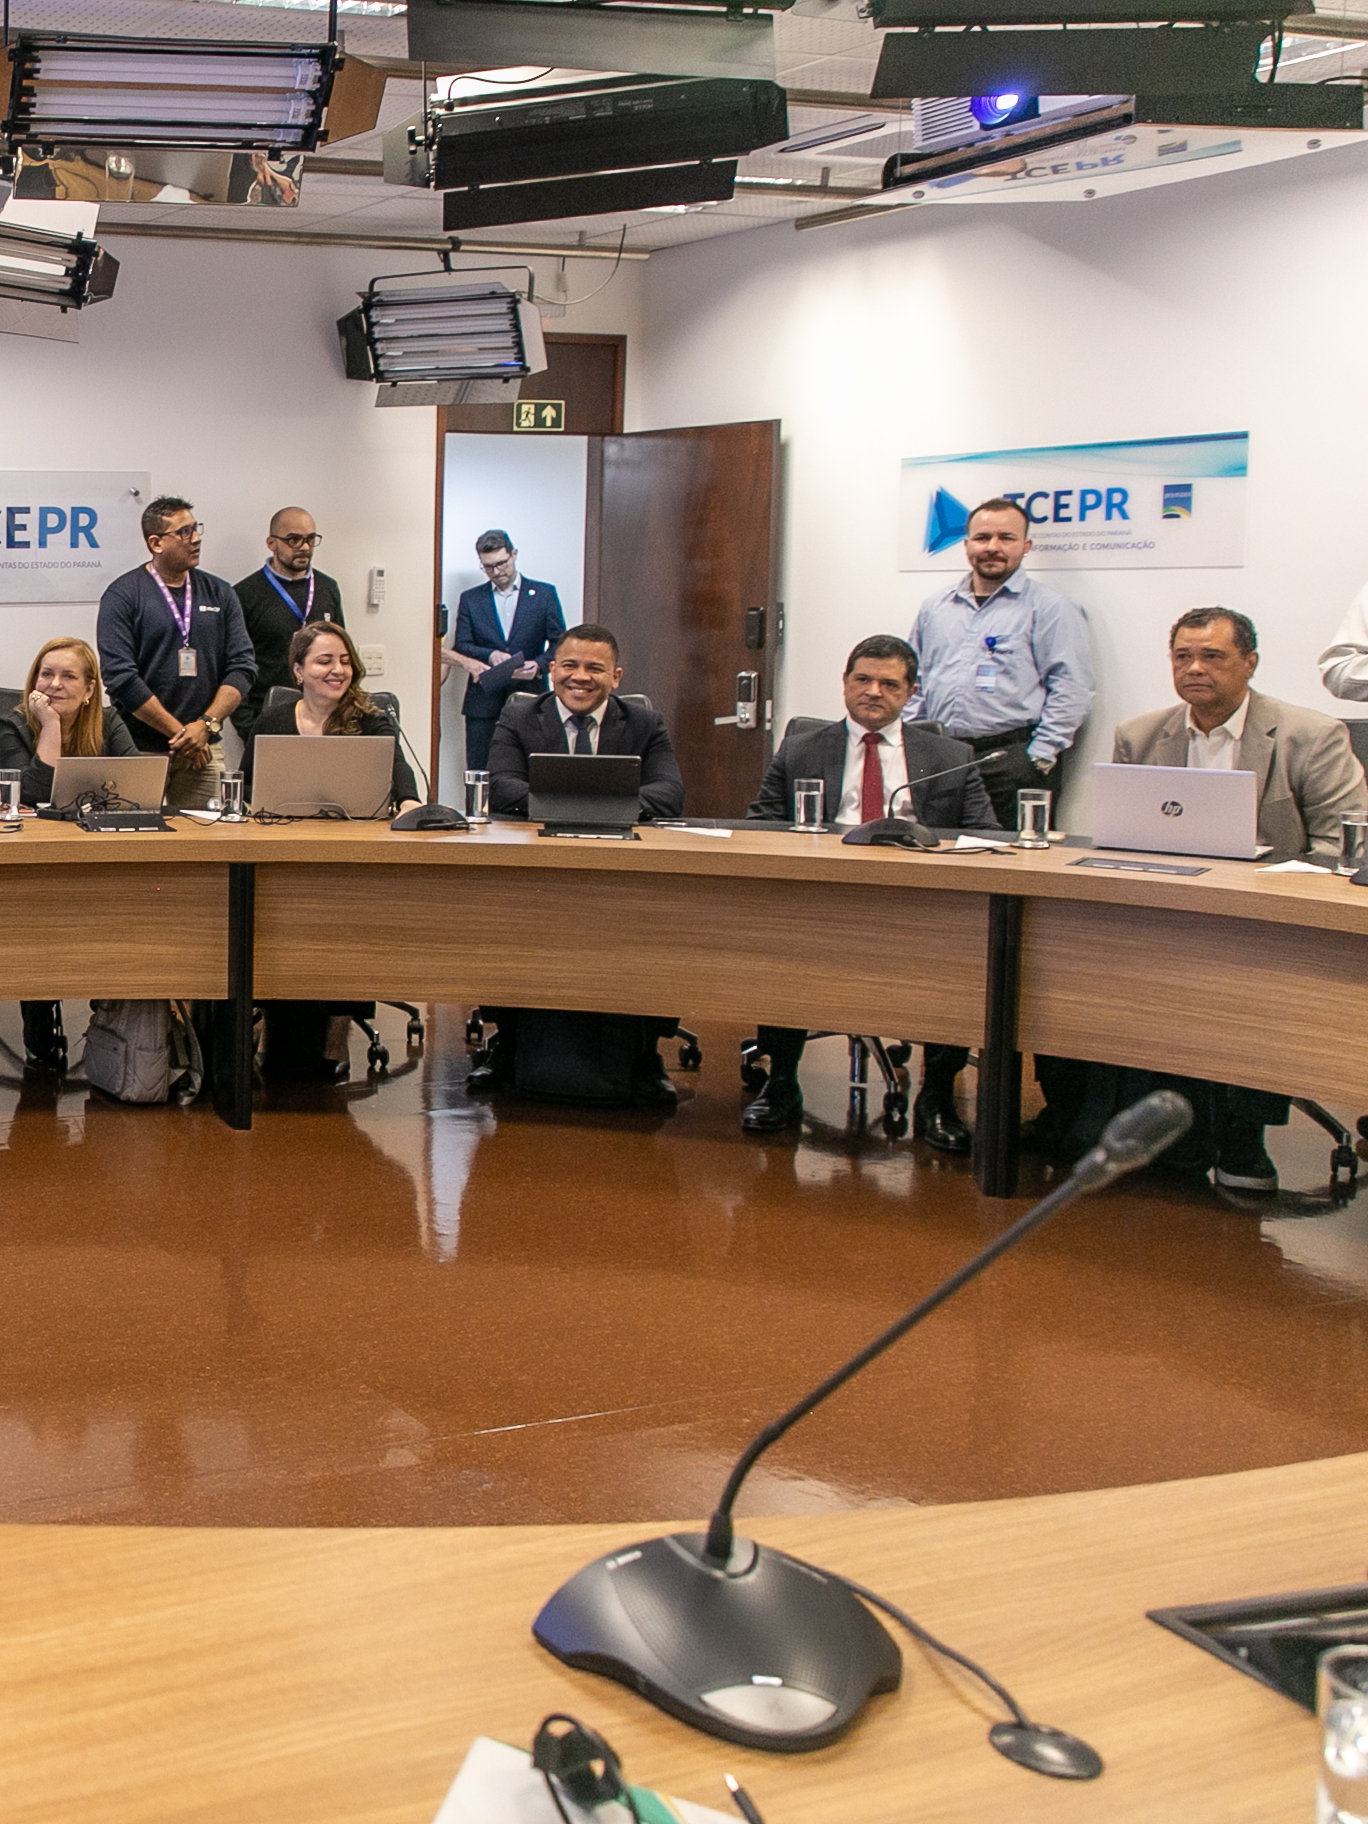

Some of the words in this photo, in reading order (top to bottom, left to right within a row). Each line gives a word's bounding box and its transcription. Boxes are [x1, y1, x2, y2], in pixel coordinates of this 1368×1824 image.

[1031, 542, 1080, 552] FORMAÇÃO
[1089, 540, 1156, 550] COMUNICAÇÃO
[61, 561, 71, 569] DO
[73, 560, 102, 569] PARANÁ
[1163, 800, 1182, 818] hp
